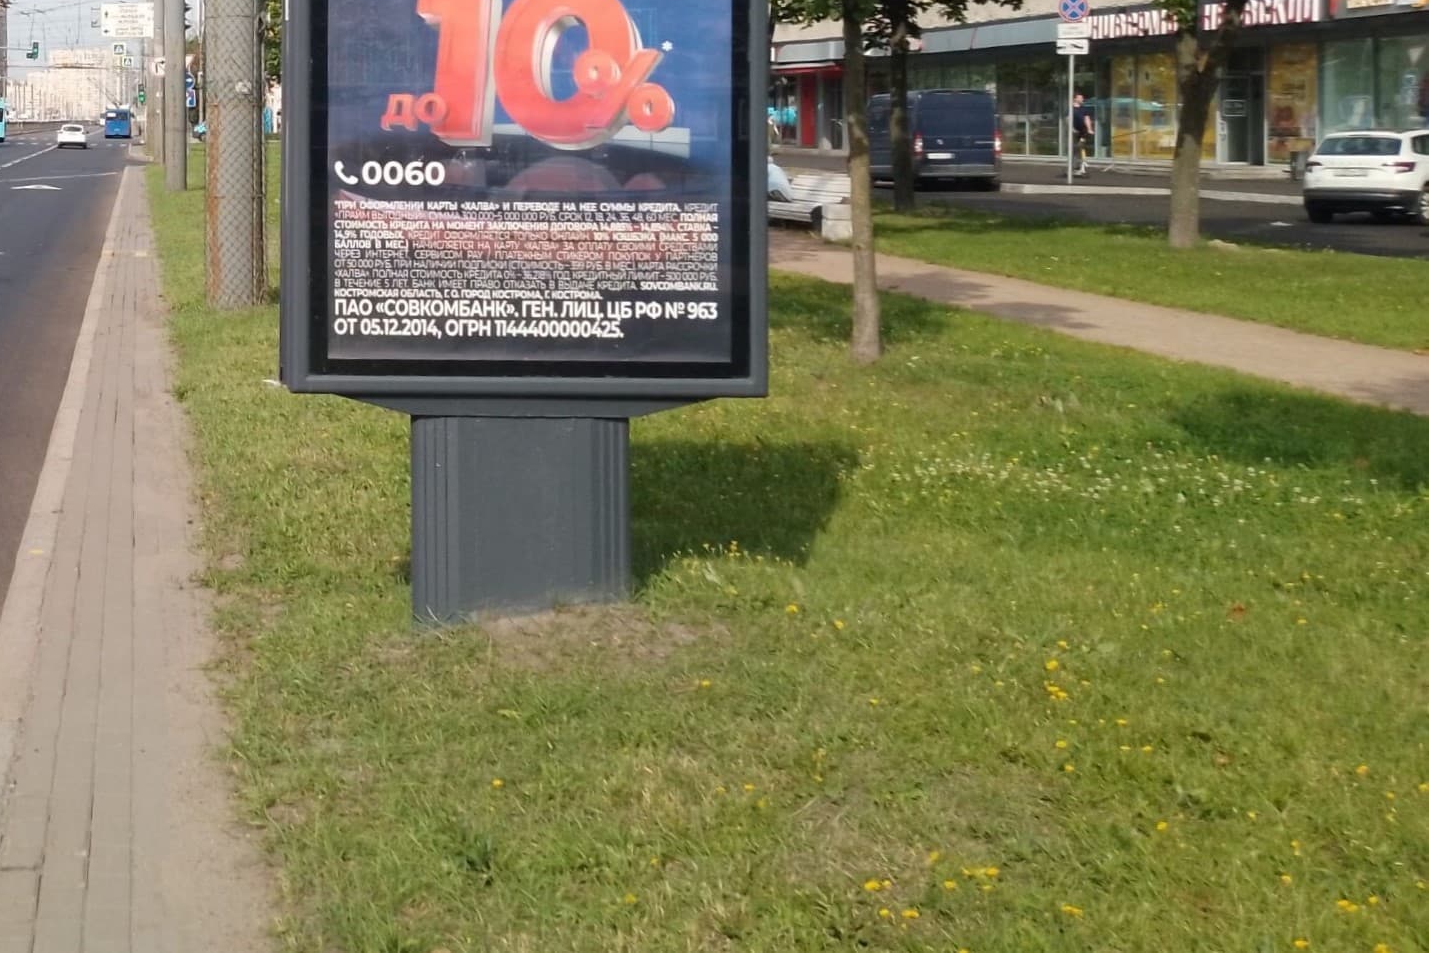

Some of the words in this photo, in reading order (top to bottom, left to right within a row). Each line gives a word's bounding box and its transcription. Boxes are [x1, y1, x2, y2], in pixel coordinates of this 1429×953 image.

[361, 161, 446, 186] 0060
[427, 201, 457, 211] КАРТЫ
[513, 201, 560, 211] ПЕРЕВОДЕ
[562, 202, 576, 212] НА
[579, 202, 598, 212] НЕЕ
[600, 202, 635, 212] СУММЫ
[684, 203, 718, 213] КРЕДИТ
[680, 213, 718, 223] ПОЛНАЯ
[334, 220, 388, 230] СТОИМОСТЬ
[390, 221, 430, 231] КРЕДИТА
[431, 221, 445, 231] НА
[447, 221, 484, 231] МОМЕНТ
[550, 222, 599, 232] ДОГОВОРА
[677, 223, 712, 233] СТАВКА
[409, 230, 440, 240] КРЕДИТ
[334, 239, 371, 249] БАЛЛОВ
[477, 240, 490, 250] НА
[334, 249, 361, 259] ЧЕРЕЗ
[372, 268, 409, 278] ПОЛНАЯ
[343, 278, 382, 288] ТЕЧЕНИЕ
[412, 279, 436, 289] БАНК
[439, 279, 467, 289] ИМЕЕТ
[470, 279, 500, 289] ПРАВО
[503, 279, 546, 289] ОТКАЗАТЬ
[334, 288, 399, 298] КОСТРОМСКАЯ
[461, 289, 490, 299] ГОРОД
[335, 299, 373, 315] ПАО
[376, 299, 519, 317] «СОВКОМБАНК».
[521, 301, 558, 318] ГЕН.
[560, 301, 604, 320] ЛИЦ.
[607, 301, 632, 320] ЦБ
[635, 302, 662, 319] РФ
[665, 302, 685, 318] №
[687, 302, 718, 319] 963
[334, 319, 357, 335] ОТ
[360, 319, 442, 338] 05.12.2014,
[445, 320, 491, 336] ОГРН
